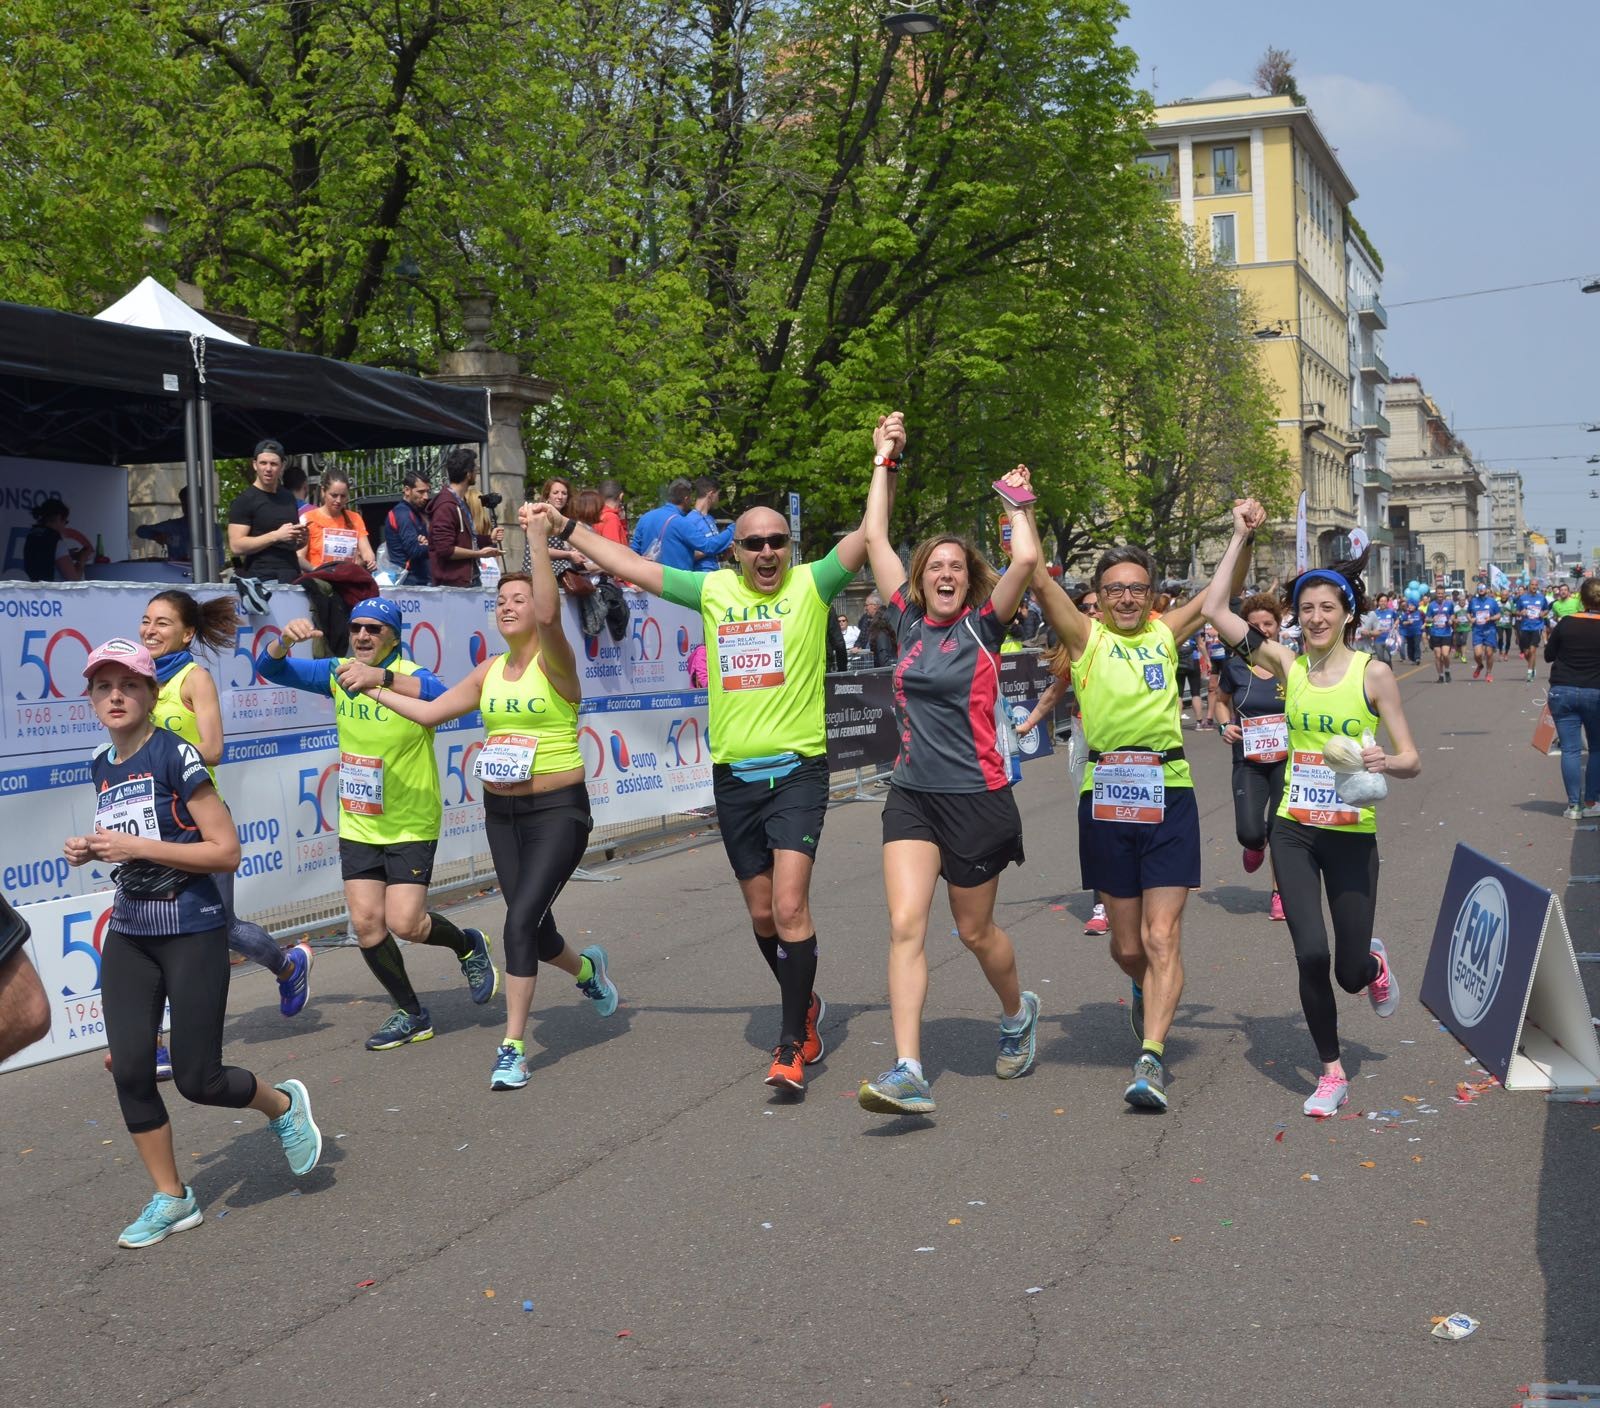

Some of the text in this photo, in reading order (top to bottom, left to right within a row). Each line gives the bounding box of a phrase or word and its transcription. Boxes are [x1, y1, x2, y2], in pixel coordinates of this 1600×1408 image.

[721, 598, 791, 622] AIRC
[600, 646, 621, 662] europ
[1108, 642, 1169, 661] AIRC
[731, 653, 771, 669] 1037D
[585, 664, 622, 679] assistance
[740, 675, 763, 686] EA7
[18, 707, 50, 724] 1968
[69, 704, 95, 721] 201
[338, 700, 388, 722] AIRC
[862, 706, 882, 723] Sogno
[27, 725, 58, 736] PROVA
[1287, 712, 1361, 738] AIRC
[228, 739, 278, 760] #corricon
[1301, 754, 1316, 762] EA7
[484, 762, 519, 777] 1029C
[632, 752, 657, 770] europ
[124, 783, 145, 793] MILANO
[346, 781, 373, 798] 1037C
[616, 773, 664, 794] assistance
[1106, 784, 1150, 801] 1029A
[351, 800, 367, 810] EA7
[1115, 806, 1141, 817] EA7
[1310, 810, 1334, 822] EA7
[106, 818, 139, 837] 710
[3, 857, 70, 891] europ
[1460, 900, 1501, 978] FOX
[1454, 959, 1487, 1002] SPORTS
[65, 1001, 104, 1023] 196
[69, 1021, 104, 1040] A PRO
